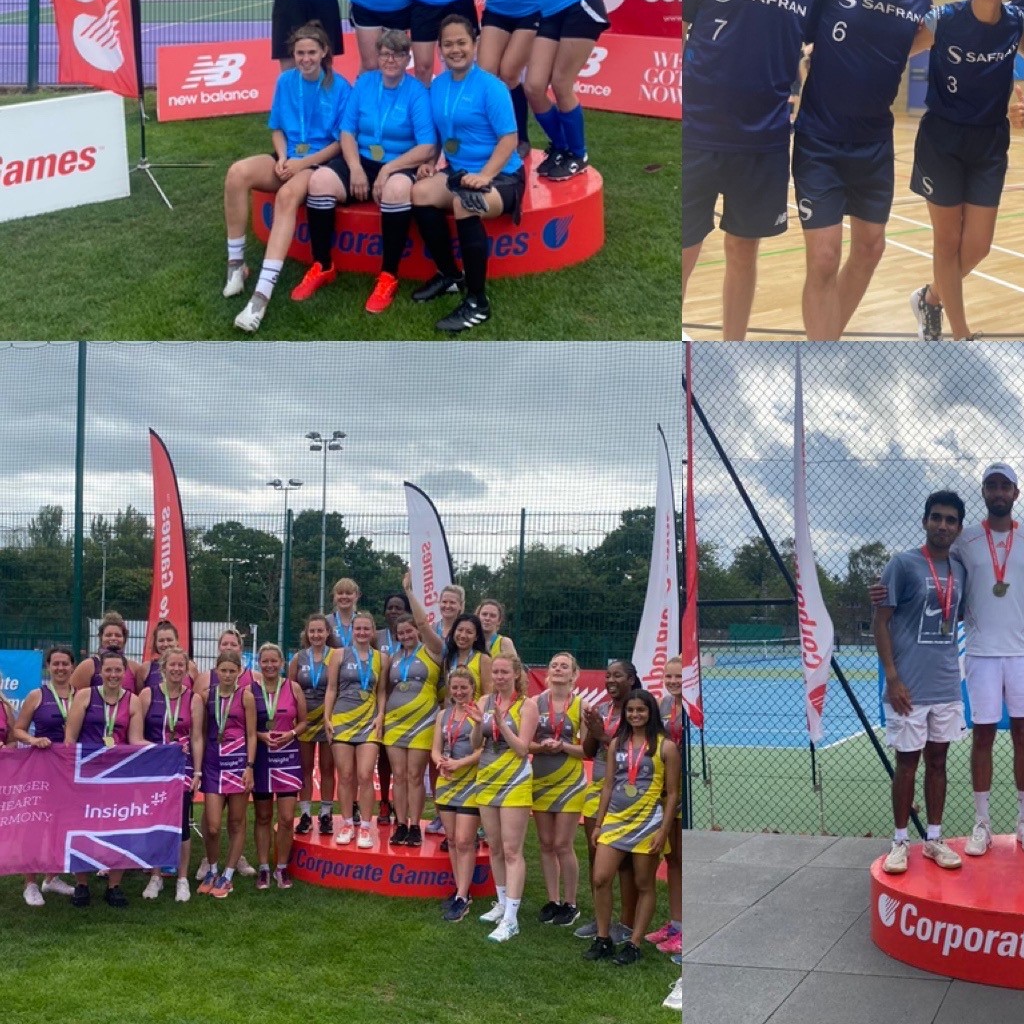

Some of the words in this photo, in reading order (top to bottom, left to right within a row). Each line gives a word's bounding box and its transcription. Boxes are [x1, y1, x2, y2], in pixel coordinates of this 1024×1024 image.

[711, 18, 728, 42] 7
[831, 21, 847, 42] 6
[946, 75, 958, 94] 3
[168, 93, 198, 106] new
[200, 89, 259, 103] balance
[0, 146, 97, 187] ames
[0, 781, 50, 795] UNGER
[0, 812, 52, 826] RMONY
[85, 802, 150, 821] Insight
[296, 848, 384, 882] Corporate
